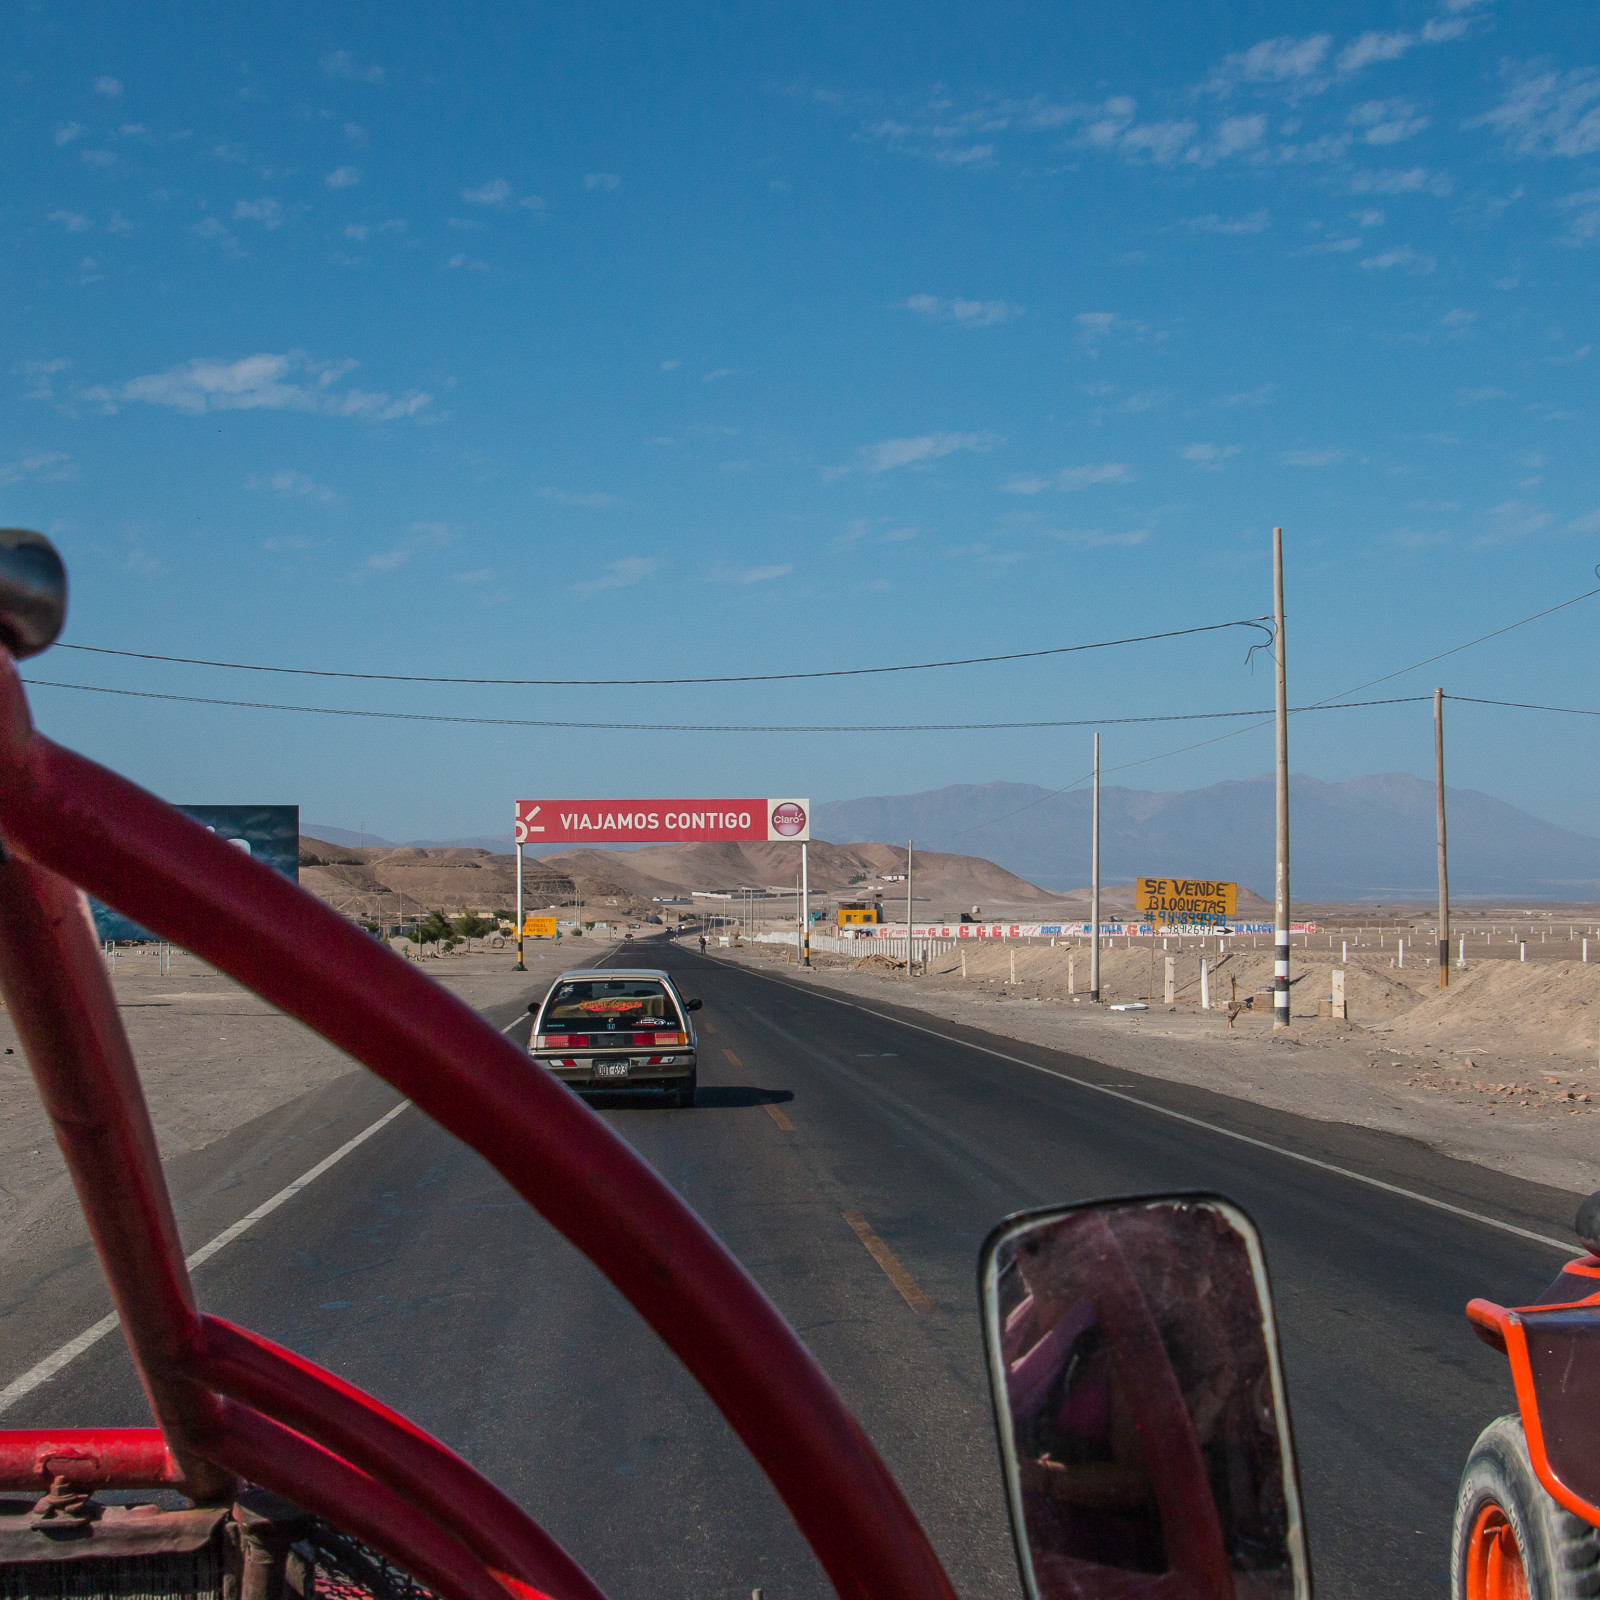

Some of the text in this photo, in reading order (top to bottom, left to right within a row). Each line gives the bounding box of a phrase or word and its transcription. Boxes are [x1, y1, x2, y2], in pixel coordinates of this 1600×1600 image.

[560, 812, 751, 830] VIAJAMOS CONTIGO
[773, 815, 801, 824] Claro
[1144, 879, 1229, 897] SE VENDE
[1144, 895, 1226, 914] BLOQUETAS
